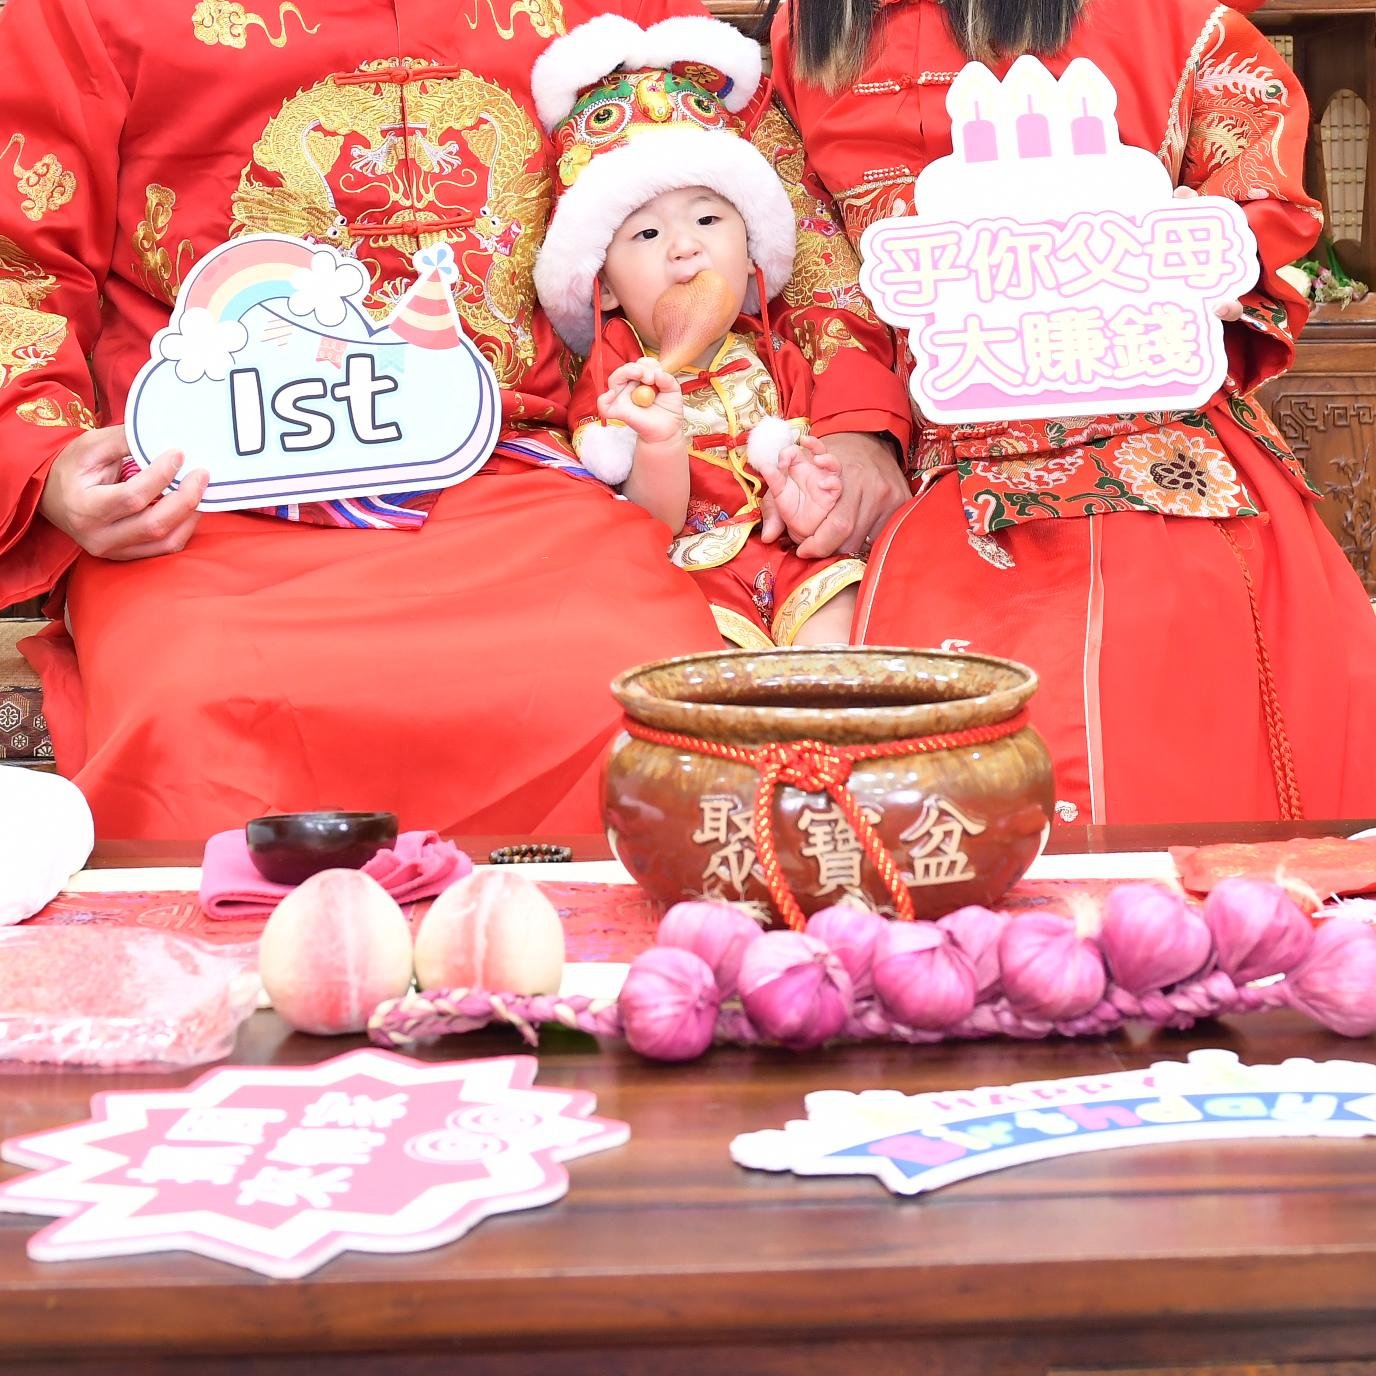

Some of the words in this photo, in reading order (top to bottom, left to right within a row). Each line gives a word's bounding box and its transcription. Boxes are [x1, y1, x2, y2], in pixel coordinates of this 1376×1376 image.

[878, 217, 1238, 304] 乎你父母
[930, 302, 1205, 392] 大賺錢
[691, 793, 986, 898] 聚寶盆
